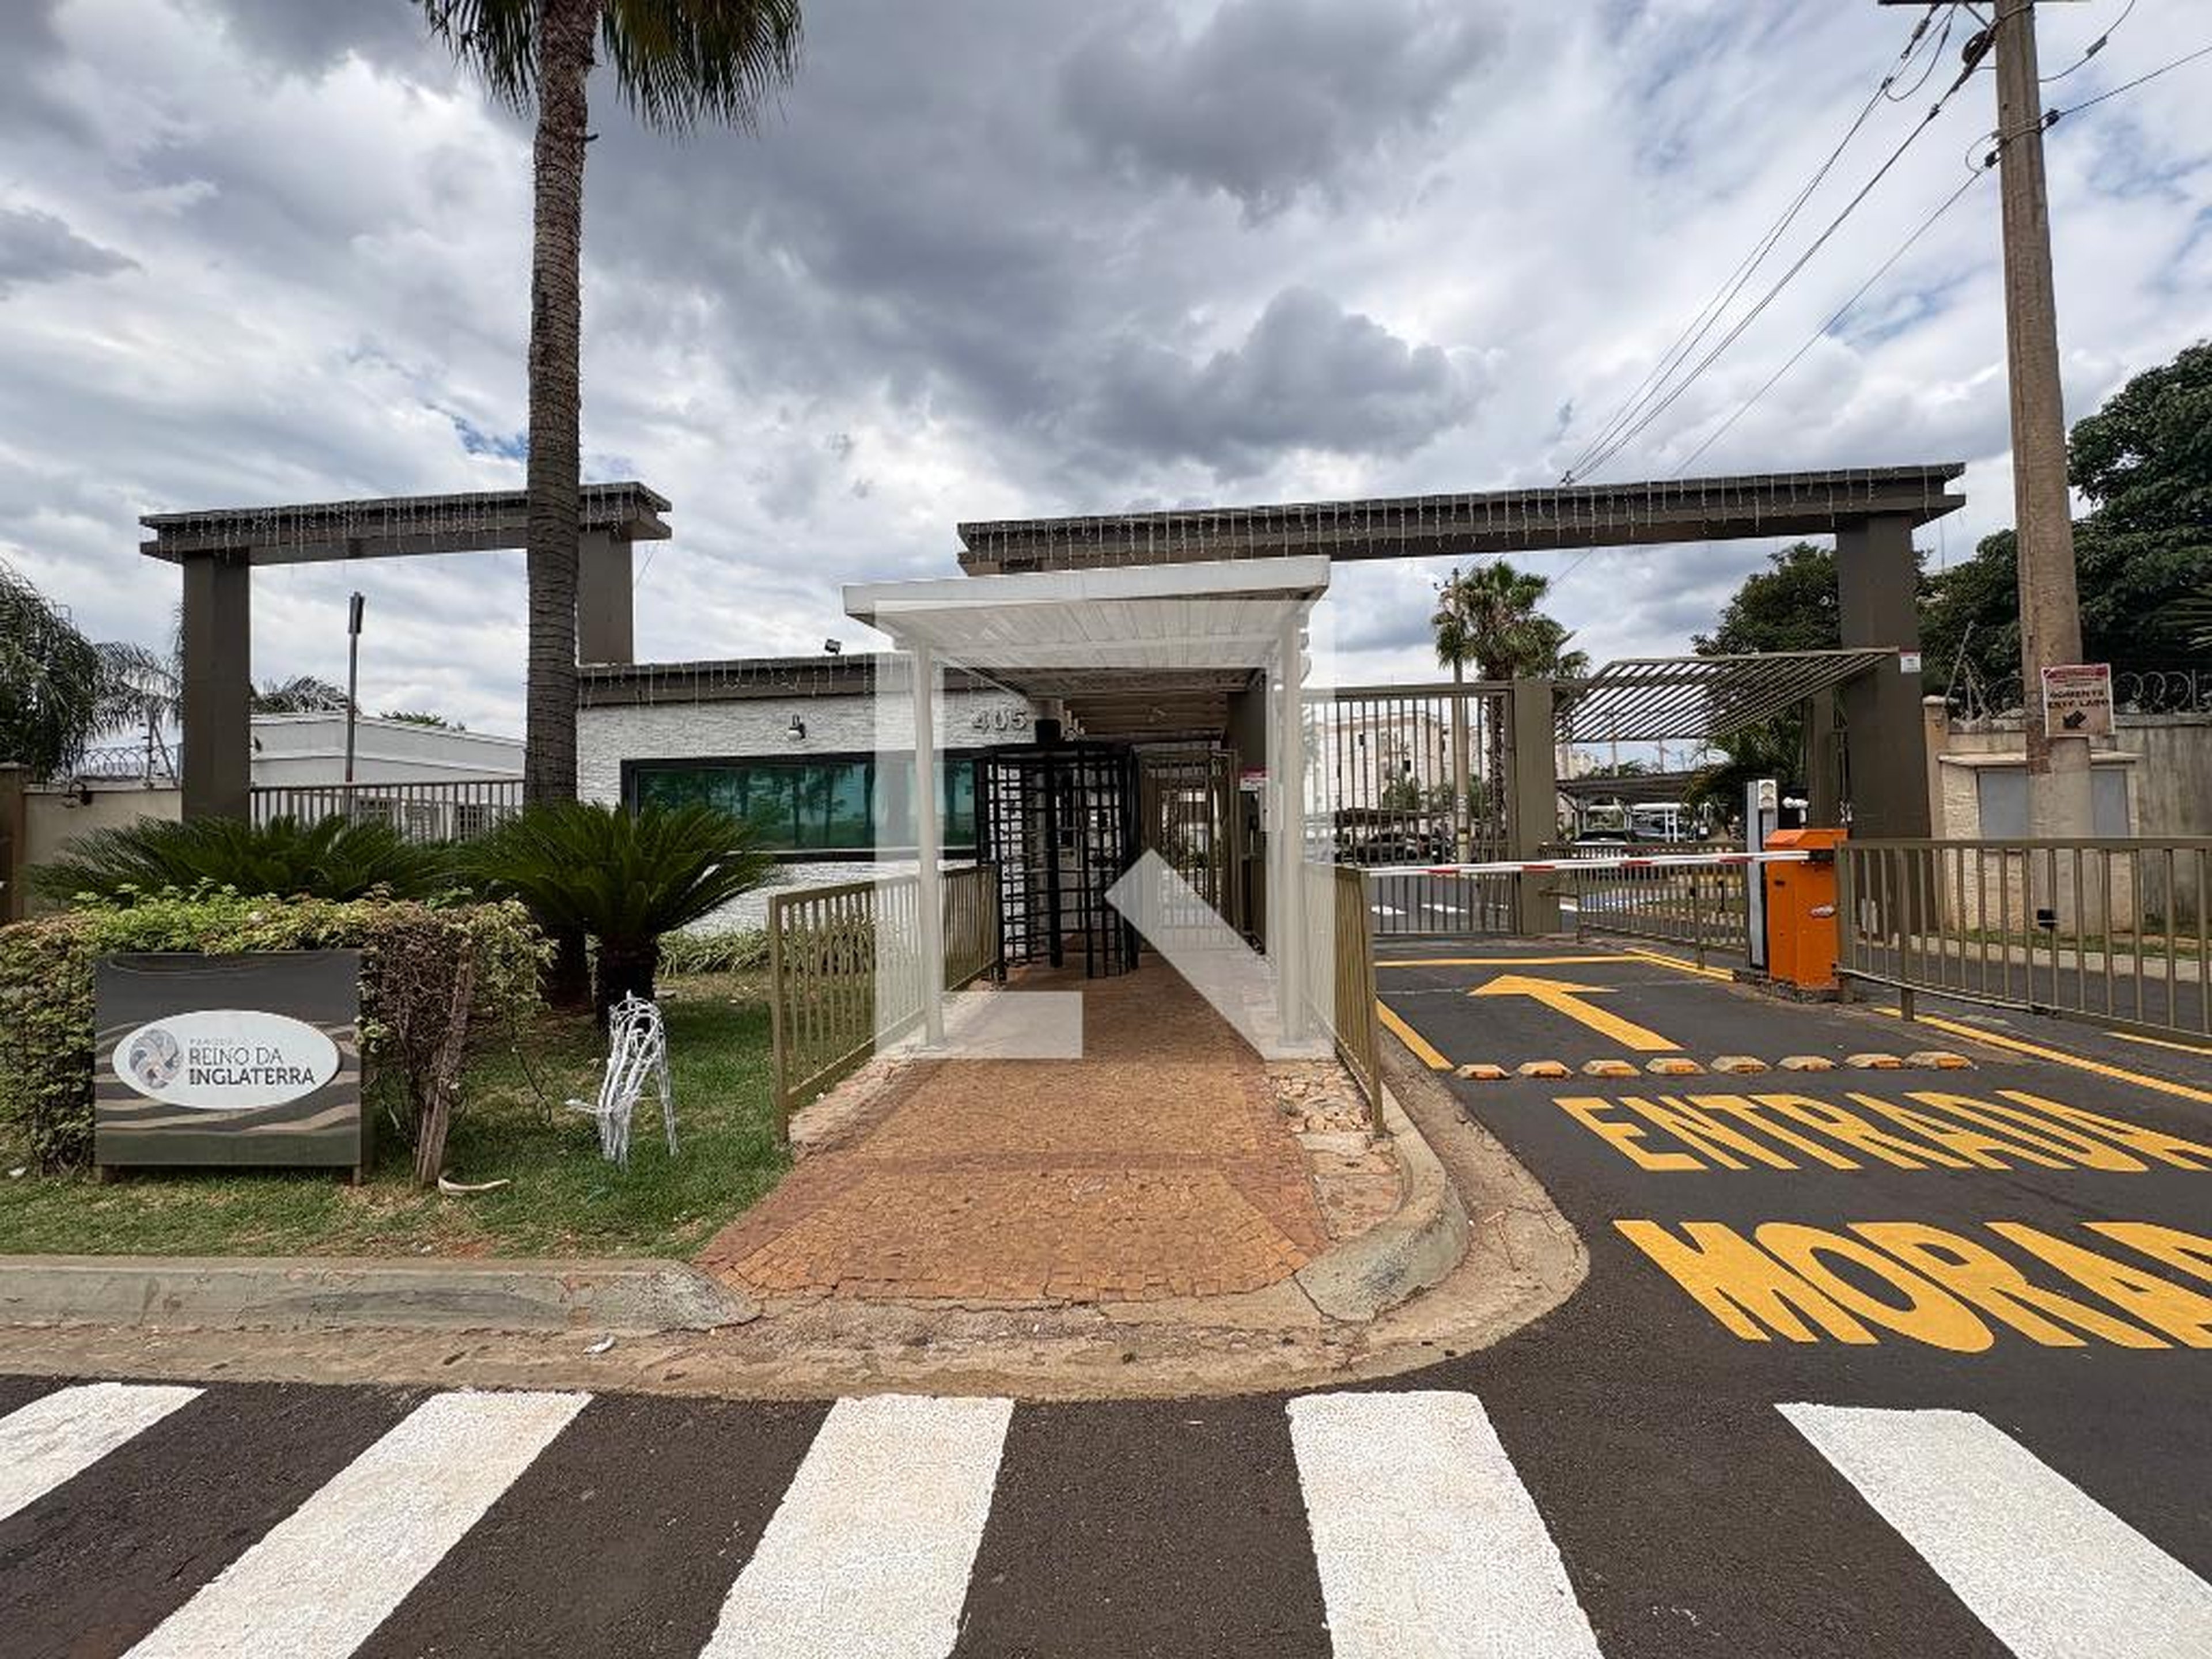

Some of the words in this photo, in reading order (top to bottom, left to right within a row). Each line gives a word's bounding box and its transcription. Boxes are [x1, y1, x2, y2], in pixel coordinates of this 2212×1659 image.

[970, 709, 1028, 732] 405
[189, 1047, 250, 1066] REINO
[256, 1047, 283, 1065] DA
[189, 1067, 316, 1085] INGLATERRA
[1552, 1090, 2212, 1172] ENTRADA
